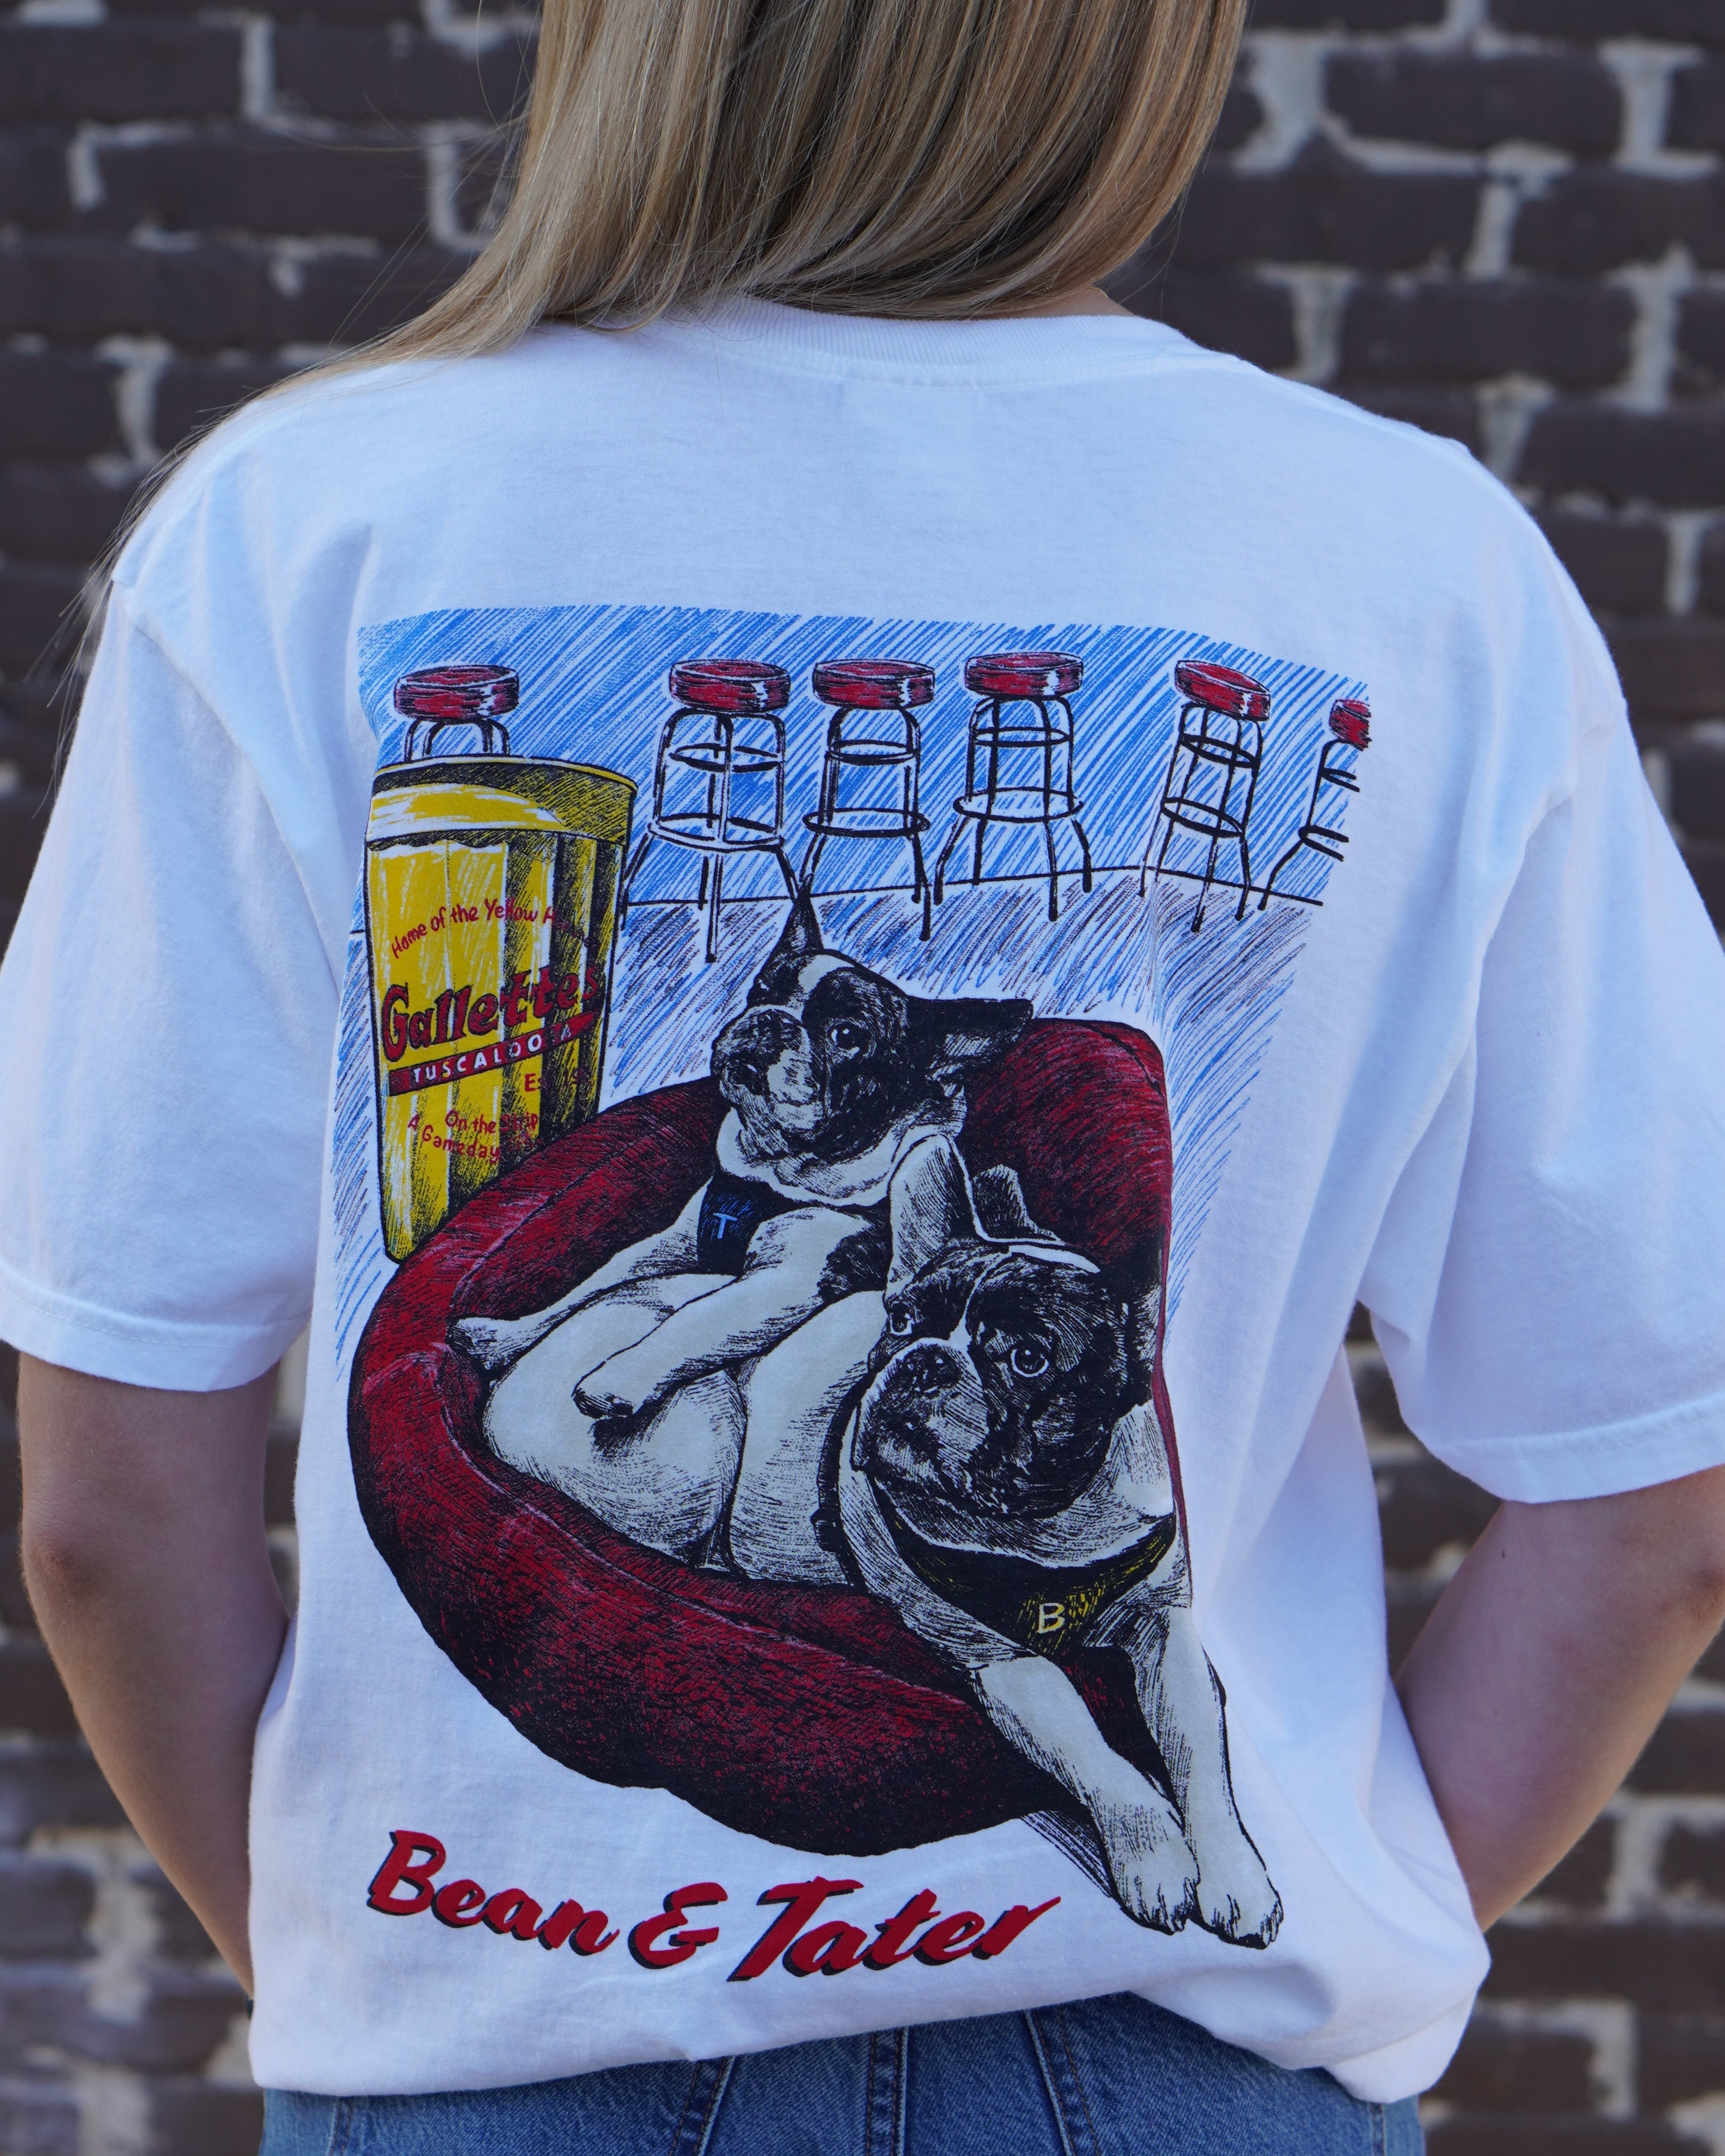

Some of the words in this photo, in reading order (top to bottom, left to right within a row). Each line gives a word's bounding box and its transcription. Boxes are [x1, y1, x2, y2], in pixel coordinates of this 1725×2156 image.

[392, 923, 428, 959] Home
[430, 906, 447, 932] of
[449, 903, 480, 923] the
[484, 897, 538, 923] Yellow
[381, 964, 599, 1062] Gallettes
[407, 1112, 420, 1131] A
[422, 1123, 501, 1165] Gameday
[445, 1109, 467, 1132] On
[472, 1113, 497, 1134] the
[713, 1212, 738, 1239] T
[1036, 1602, 1065, 1634] B
[367, 1829, 620, 1957] Bean
[627, 1882, 728, 1971] &
[727, 1875, 1061, 1982] Tater
